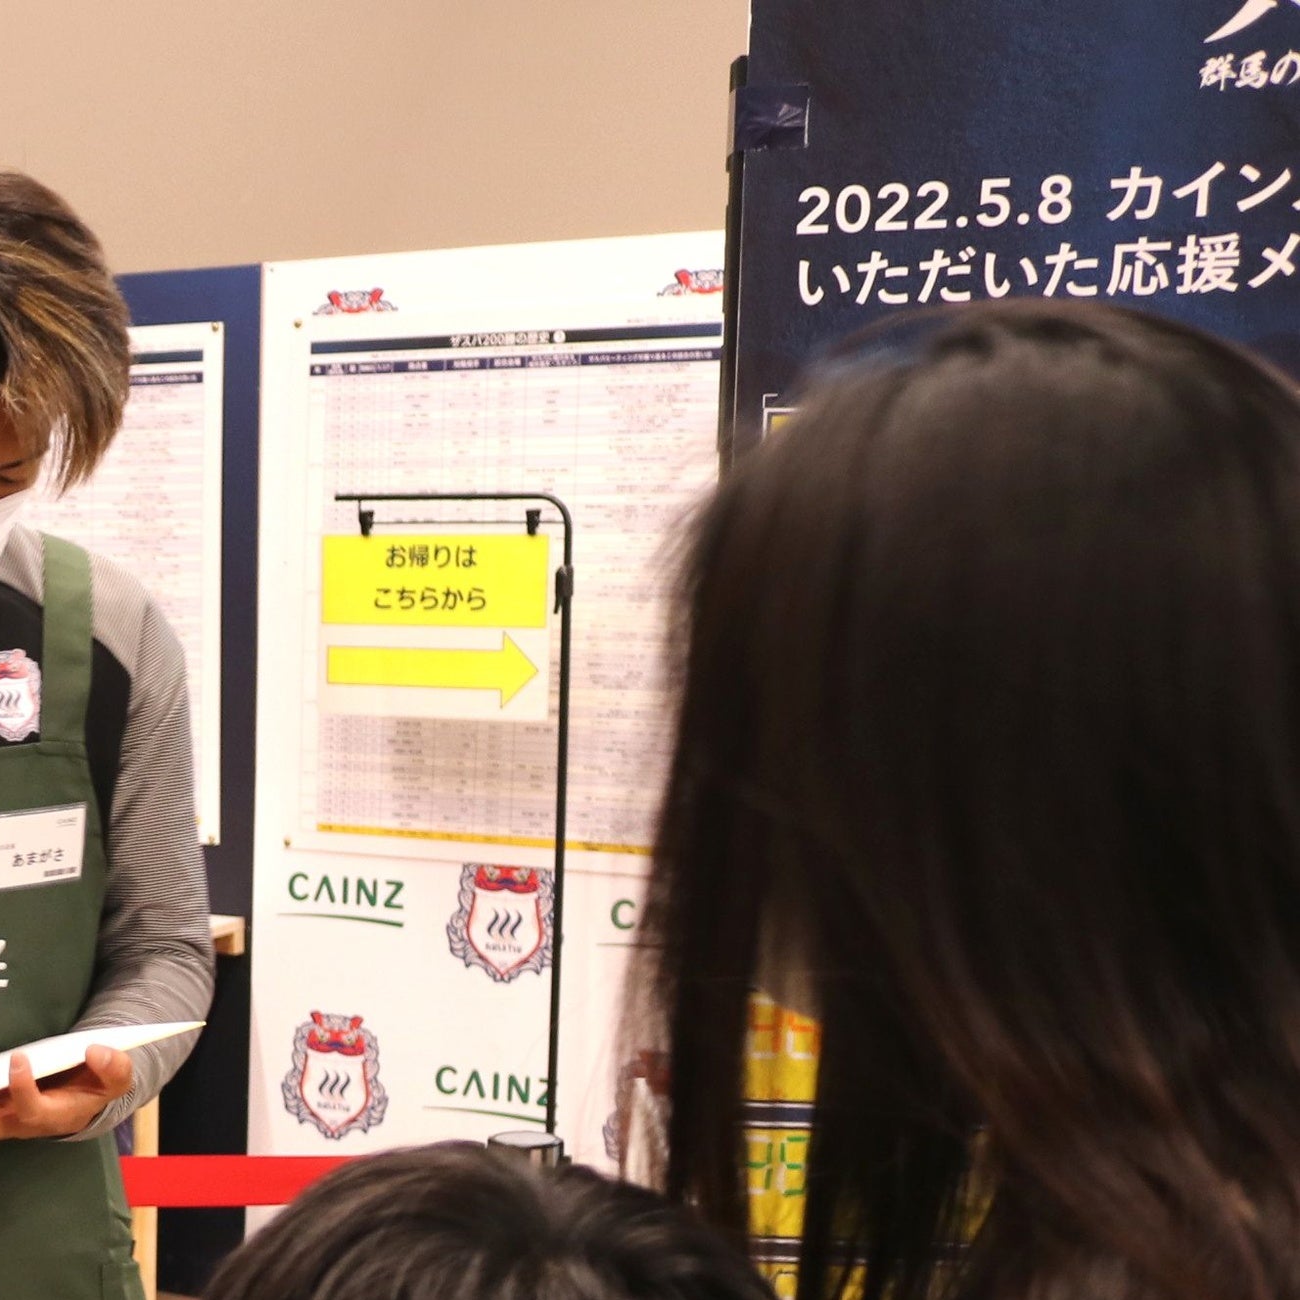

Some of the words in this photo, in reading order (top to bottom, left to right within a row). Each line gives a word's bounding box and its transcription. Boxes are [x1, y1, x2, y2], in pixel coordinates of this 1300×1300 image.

[796, 175, 1073, 235] 2022.5.8
[1106, 161, 1300, 222] カイン
[798, 233, 1300, 306] いただいた応援メ
[385, 545, 477, 568] お帰りは
[373, 588, 487, 611] こちらから
[12, 848, 64, 867] あまがさ
[289, 873, 404, 909] CAINZ
